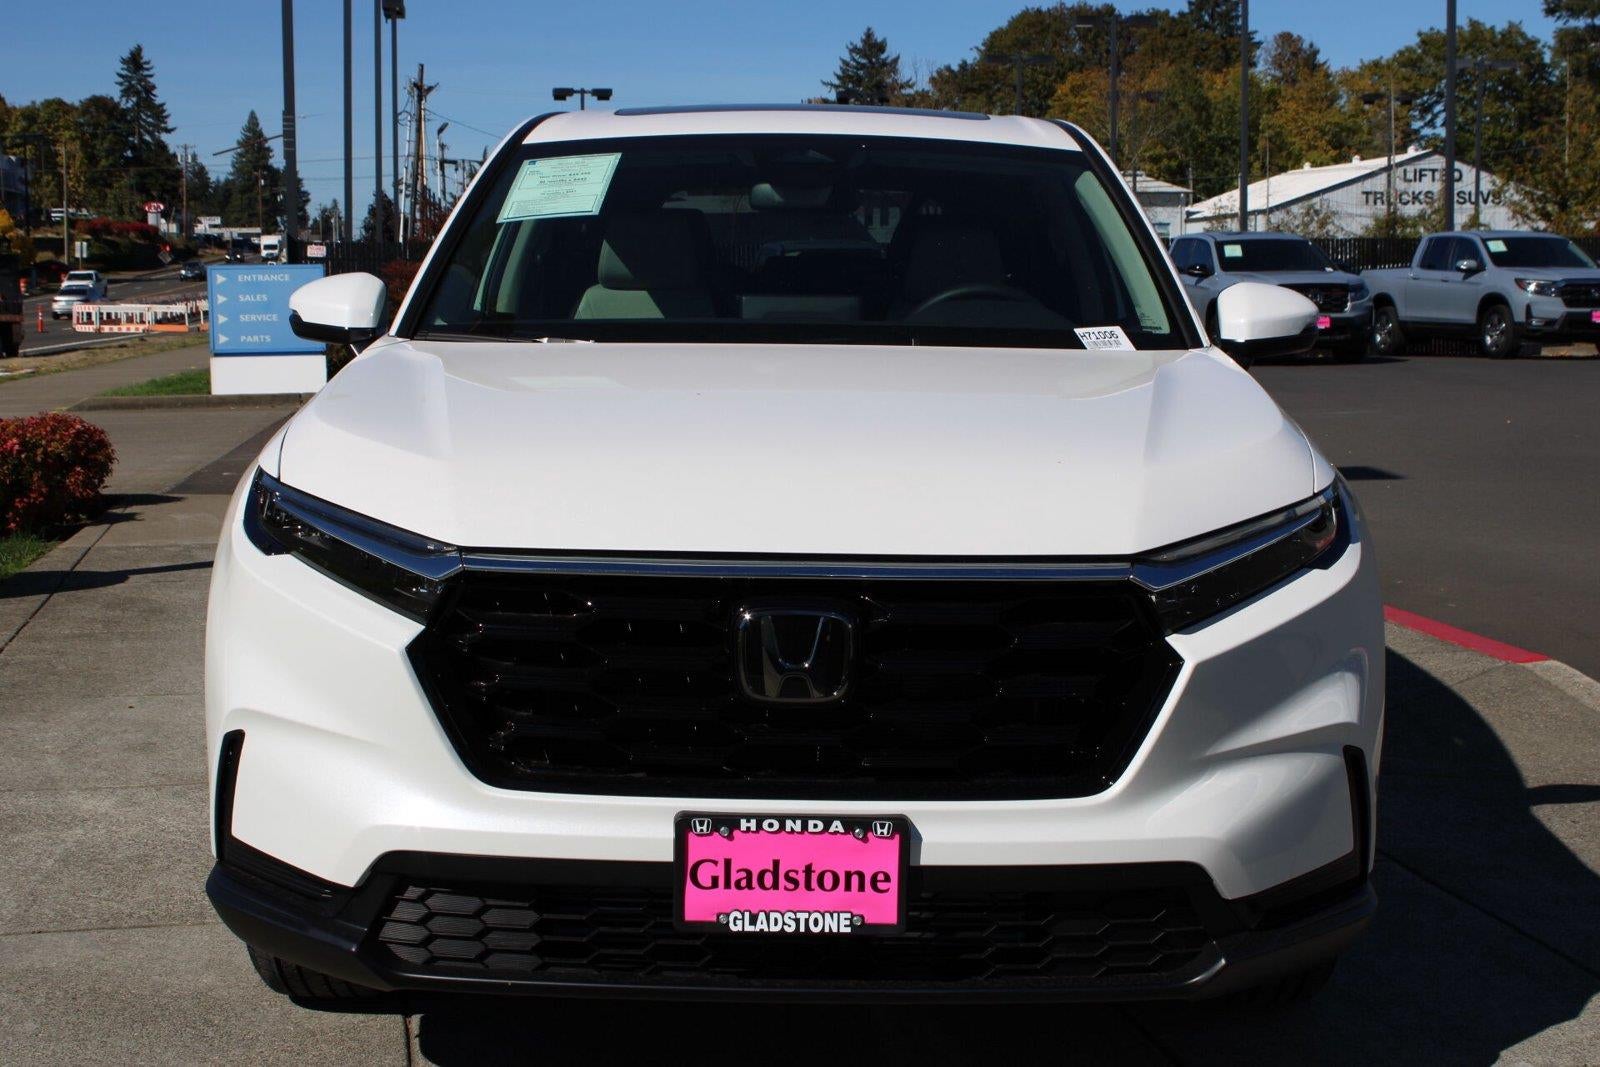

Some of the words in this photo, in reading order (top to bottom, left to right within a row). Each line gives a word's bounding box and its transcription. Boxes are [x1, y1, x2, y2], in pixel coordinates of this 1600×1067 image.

[1403, 168, 1463, 183] LIFTD
[1361, 190, 1435, 206] TRCKS
[238, 274, 290, 282] ENTRANCE
[239, 294, 268, 302] SALES
[240, 314, 278, 322] SERVICE
[1078, 330, 1119, 341] H71006
[739, 818, 845, 833] HONDA
[689, 857, 892, 894] Gladstone
[728, 910, 852, 933] GLADSTONE
